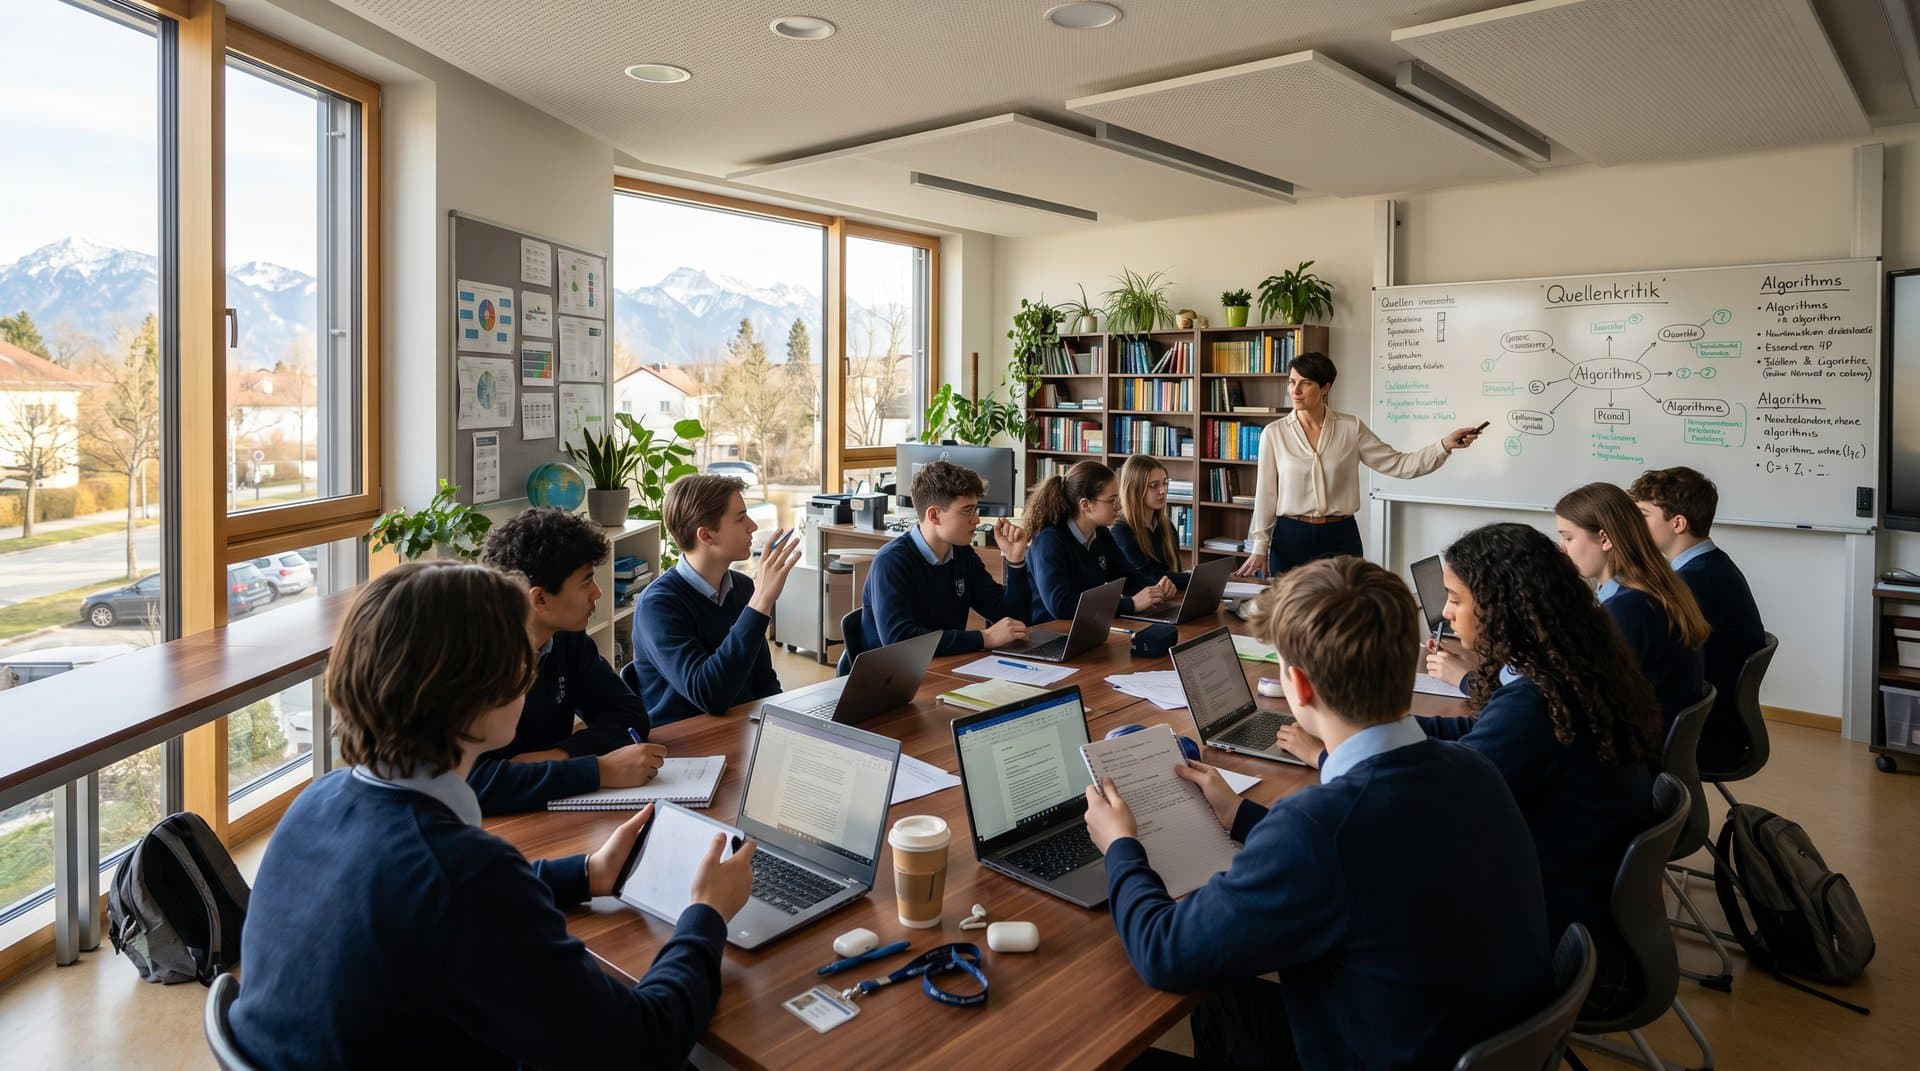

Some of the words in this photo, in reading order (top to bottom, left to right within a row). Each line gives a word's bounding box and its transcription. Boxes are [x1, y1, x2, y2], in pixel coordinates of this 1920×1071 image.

[1761, 274, 1842, 295] Algorithms
[1381, 297, 1414, 308] Quellen
[1765, 300, 1828, 316] Algorithms
[1803, 356, 1812, 365] &
[1575, 366, 1643, 385] Algorithms
[1667, 401, 1724, 415] Algorithme
[1758, 392, 1822, 409] Algorithm
